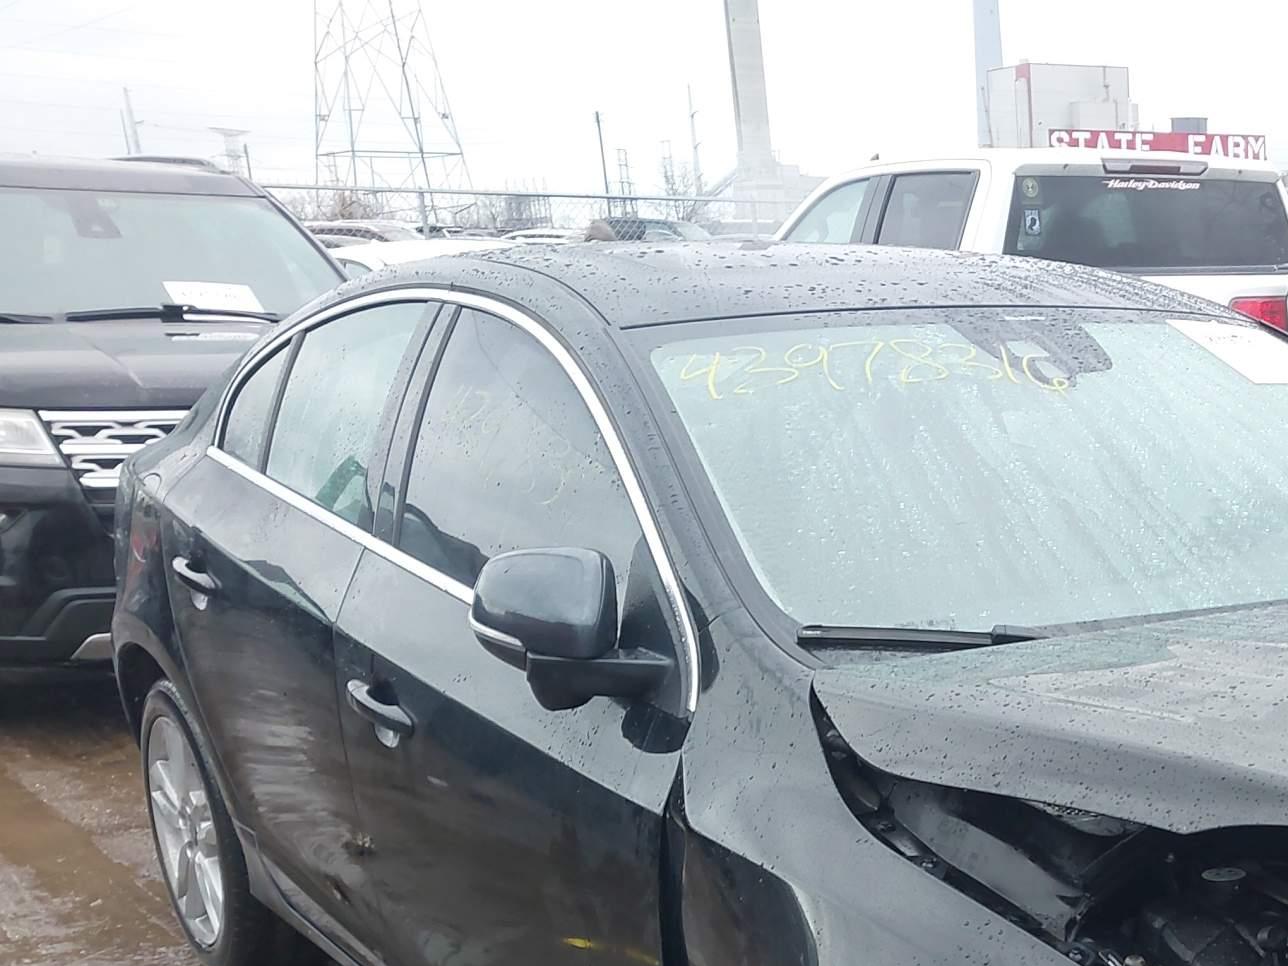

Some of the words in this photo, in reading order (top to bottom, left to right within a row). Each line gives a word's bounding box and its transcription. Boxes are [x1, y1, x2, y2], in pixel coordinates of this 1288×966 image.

[1050, 132, 1154, 151] STATE
[1187, 134, 1266, 160] FARM
[680, 339, 1069, 400] 43978316
